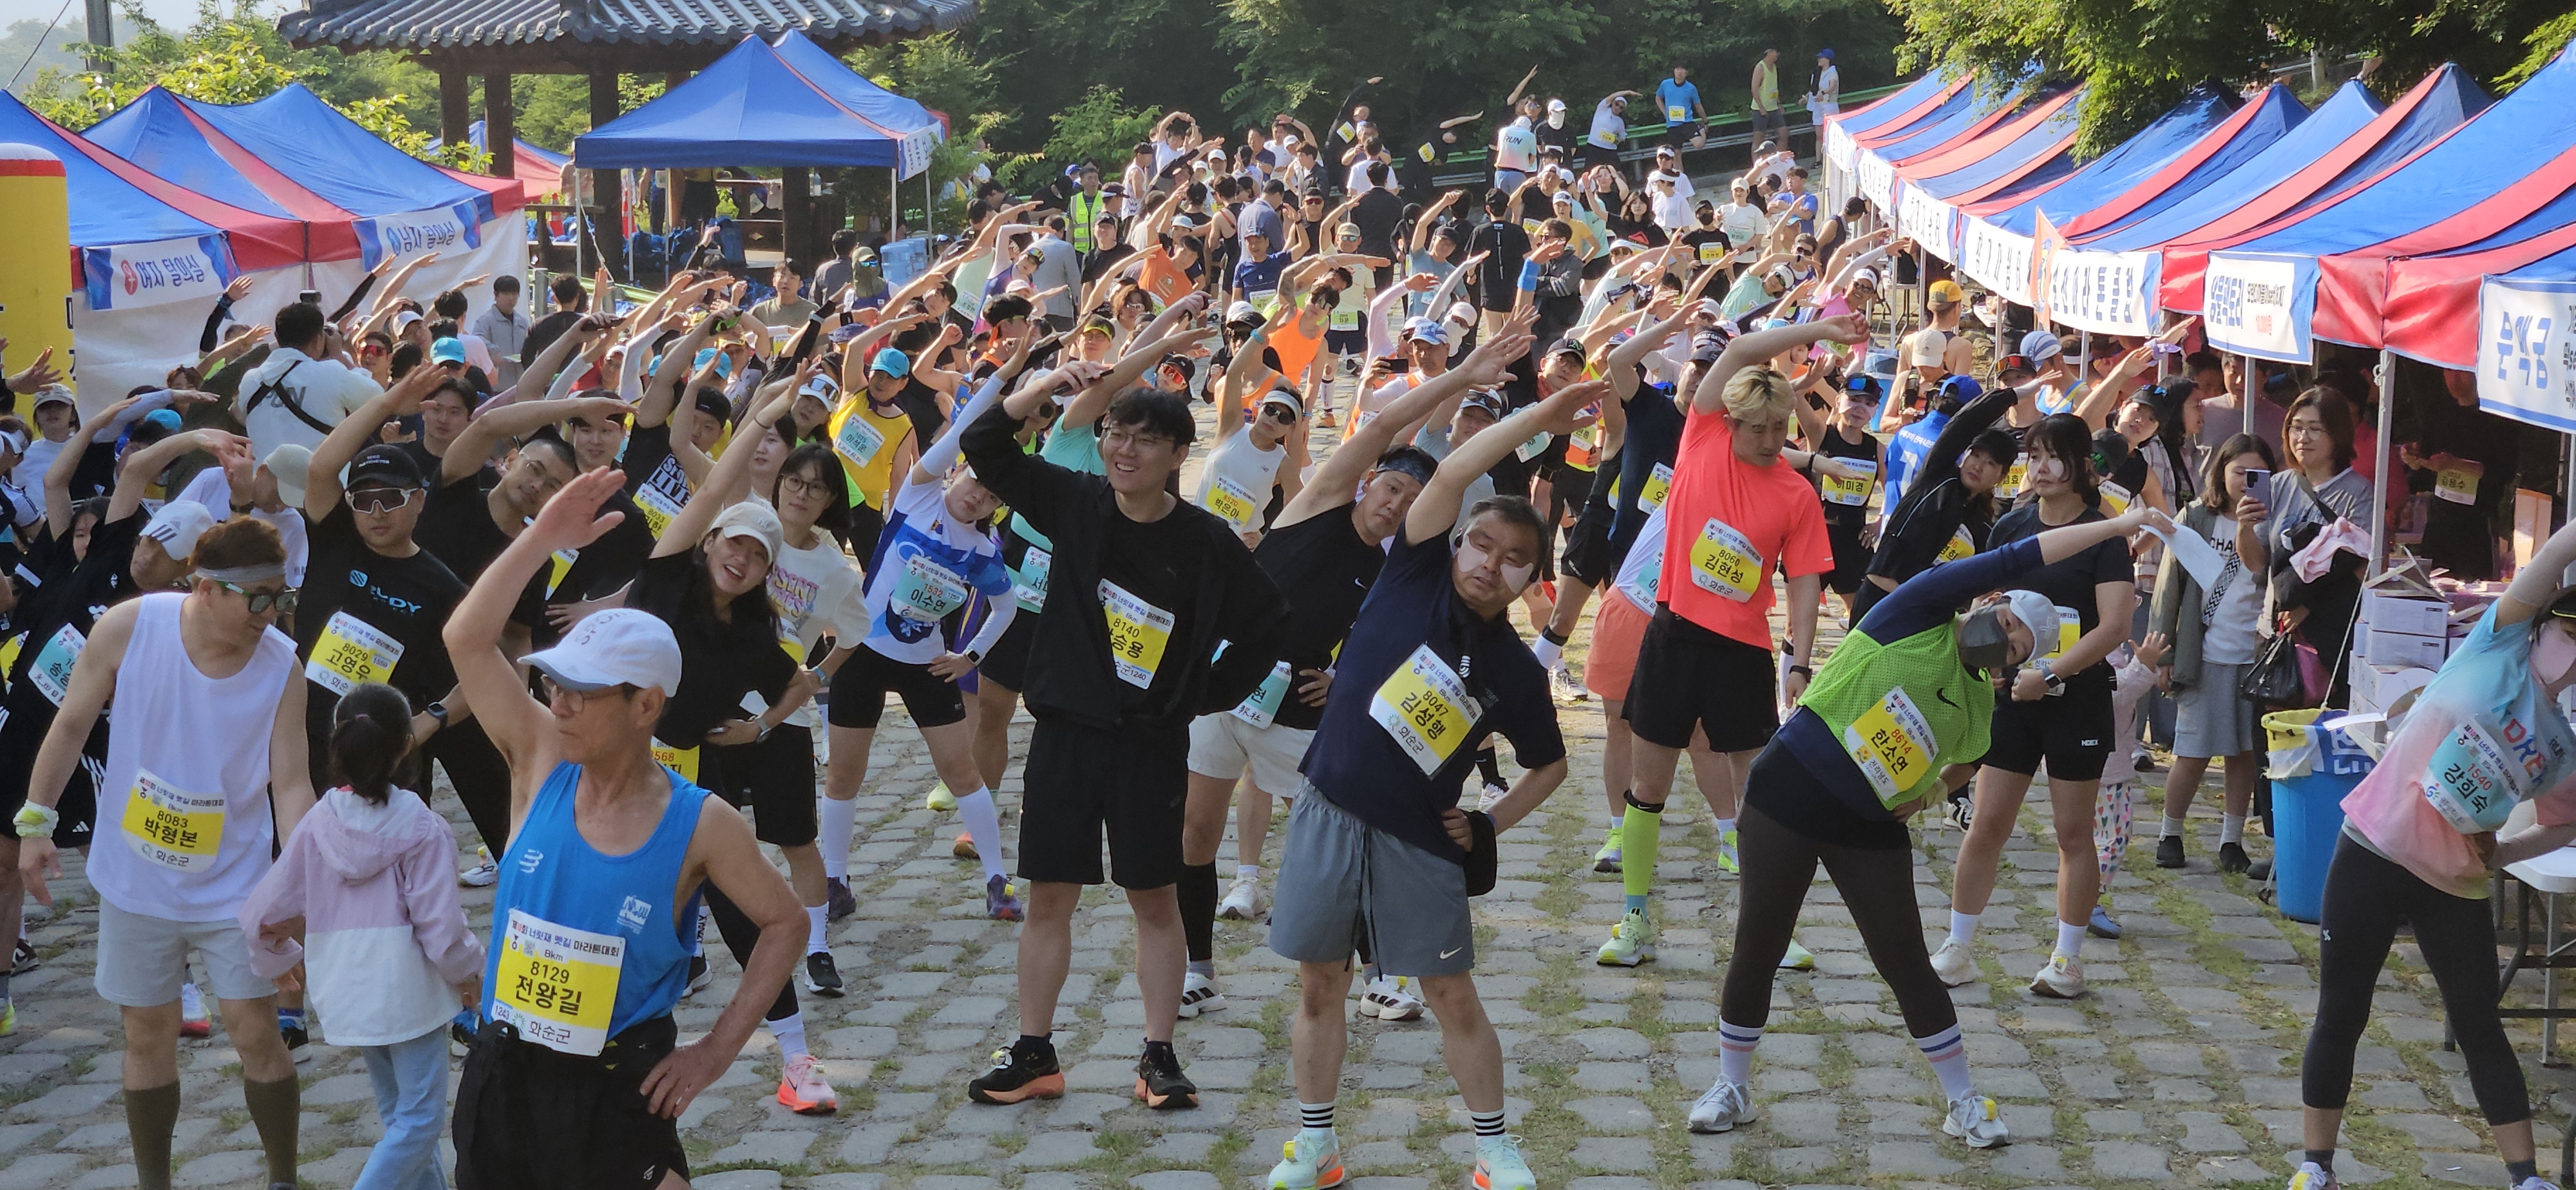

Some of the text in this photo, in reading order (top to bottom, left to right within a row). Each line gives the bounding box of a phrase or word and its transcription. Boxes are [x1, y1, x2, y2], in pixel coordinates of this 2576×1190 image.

[1504, 135, 1522, 145] RUN
[397, 221, 456, 252] 남자 탈의실
[135, 254, 205, 288] 여자 탈의실
[1215, 497, 1240, 519] 박은아
[1704, 553, 1745, 584] 김현성
[1718, 549, 1741, 567] 8060
[910, 589, 947, 612] 이수연
[923, 583, 944, 599] 1532
[1113, 618, 1140, 639] 8140
[325, 648, 372, 680] 고영우
[341, 643, 369, 662] 8029
[330, 677, 349, 693] 화순
[1400, 692, 1446, 741] 김성행
[1422, 690, 1449, 717] 8047
[1398, 725, 1425, 755] 화순군
[1870, 728, 1909, 775] 한소연
[1890, 728, 1913, 755] 8614
[2443, 762, 2489, 815] 강희숙
[2467, 762, 2493, 791] 1540
[144, 816, 198, 849] 박형본
[156, 809, 189, 829] 8083
[155, 849, 190, 867] 화순군
[544, 949, 564, 962] 8km
[530, 960, 571, 985] 8129
[515, 974, 583, 1017] 전왕길
[527, 1019, 572, 1046] 화순군
